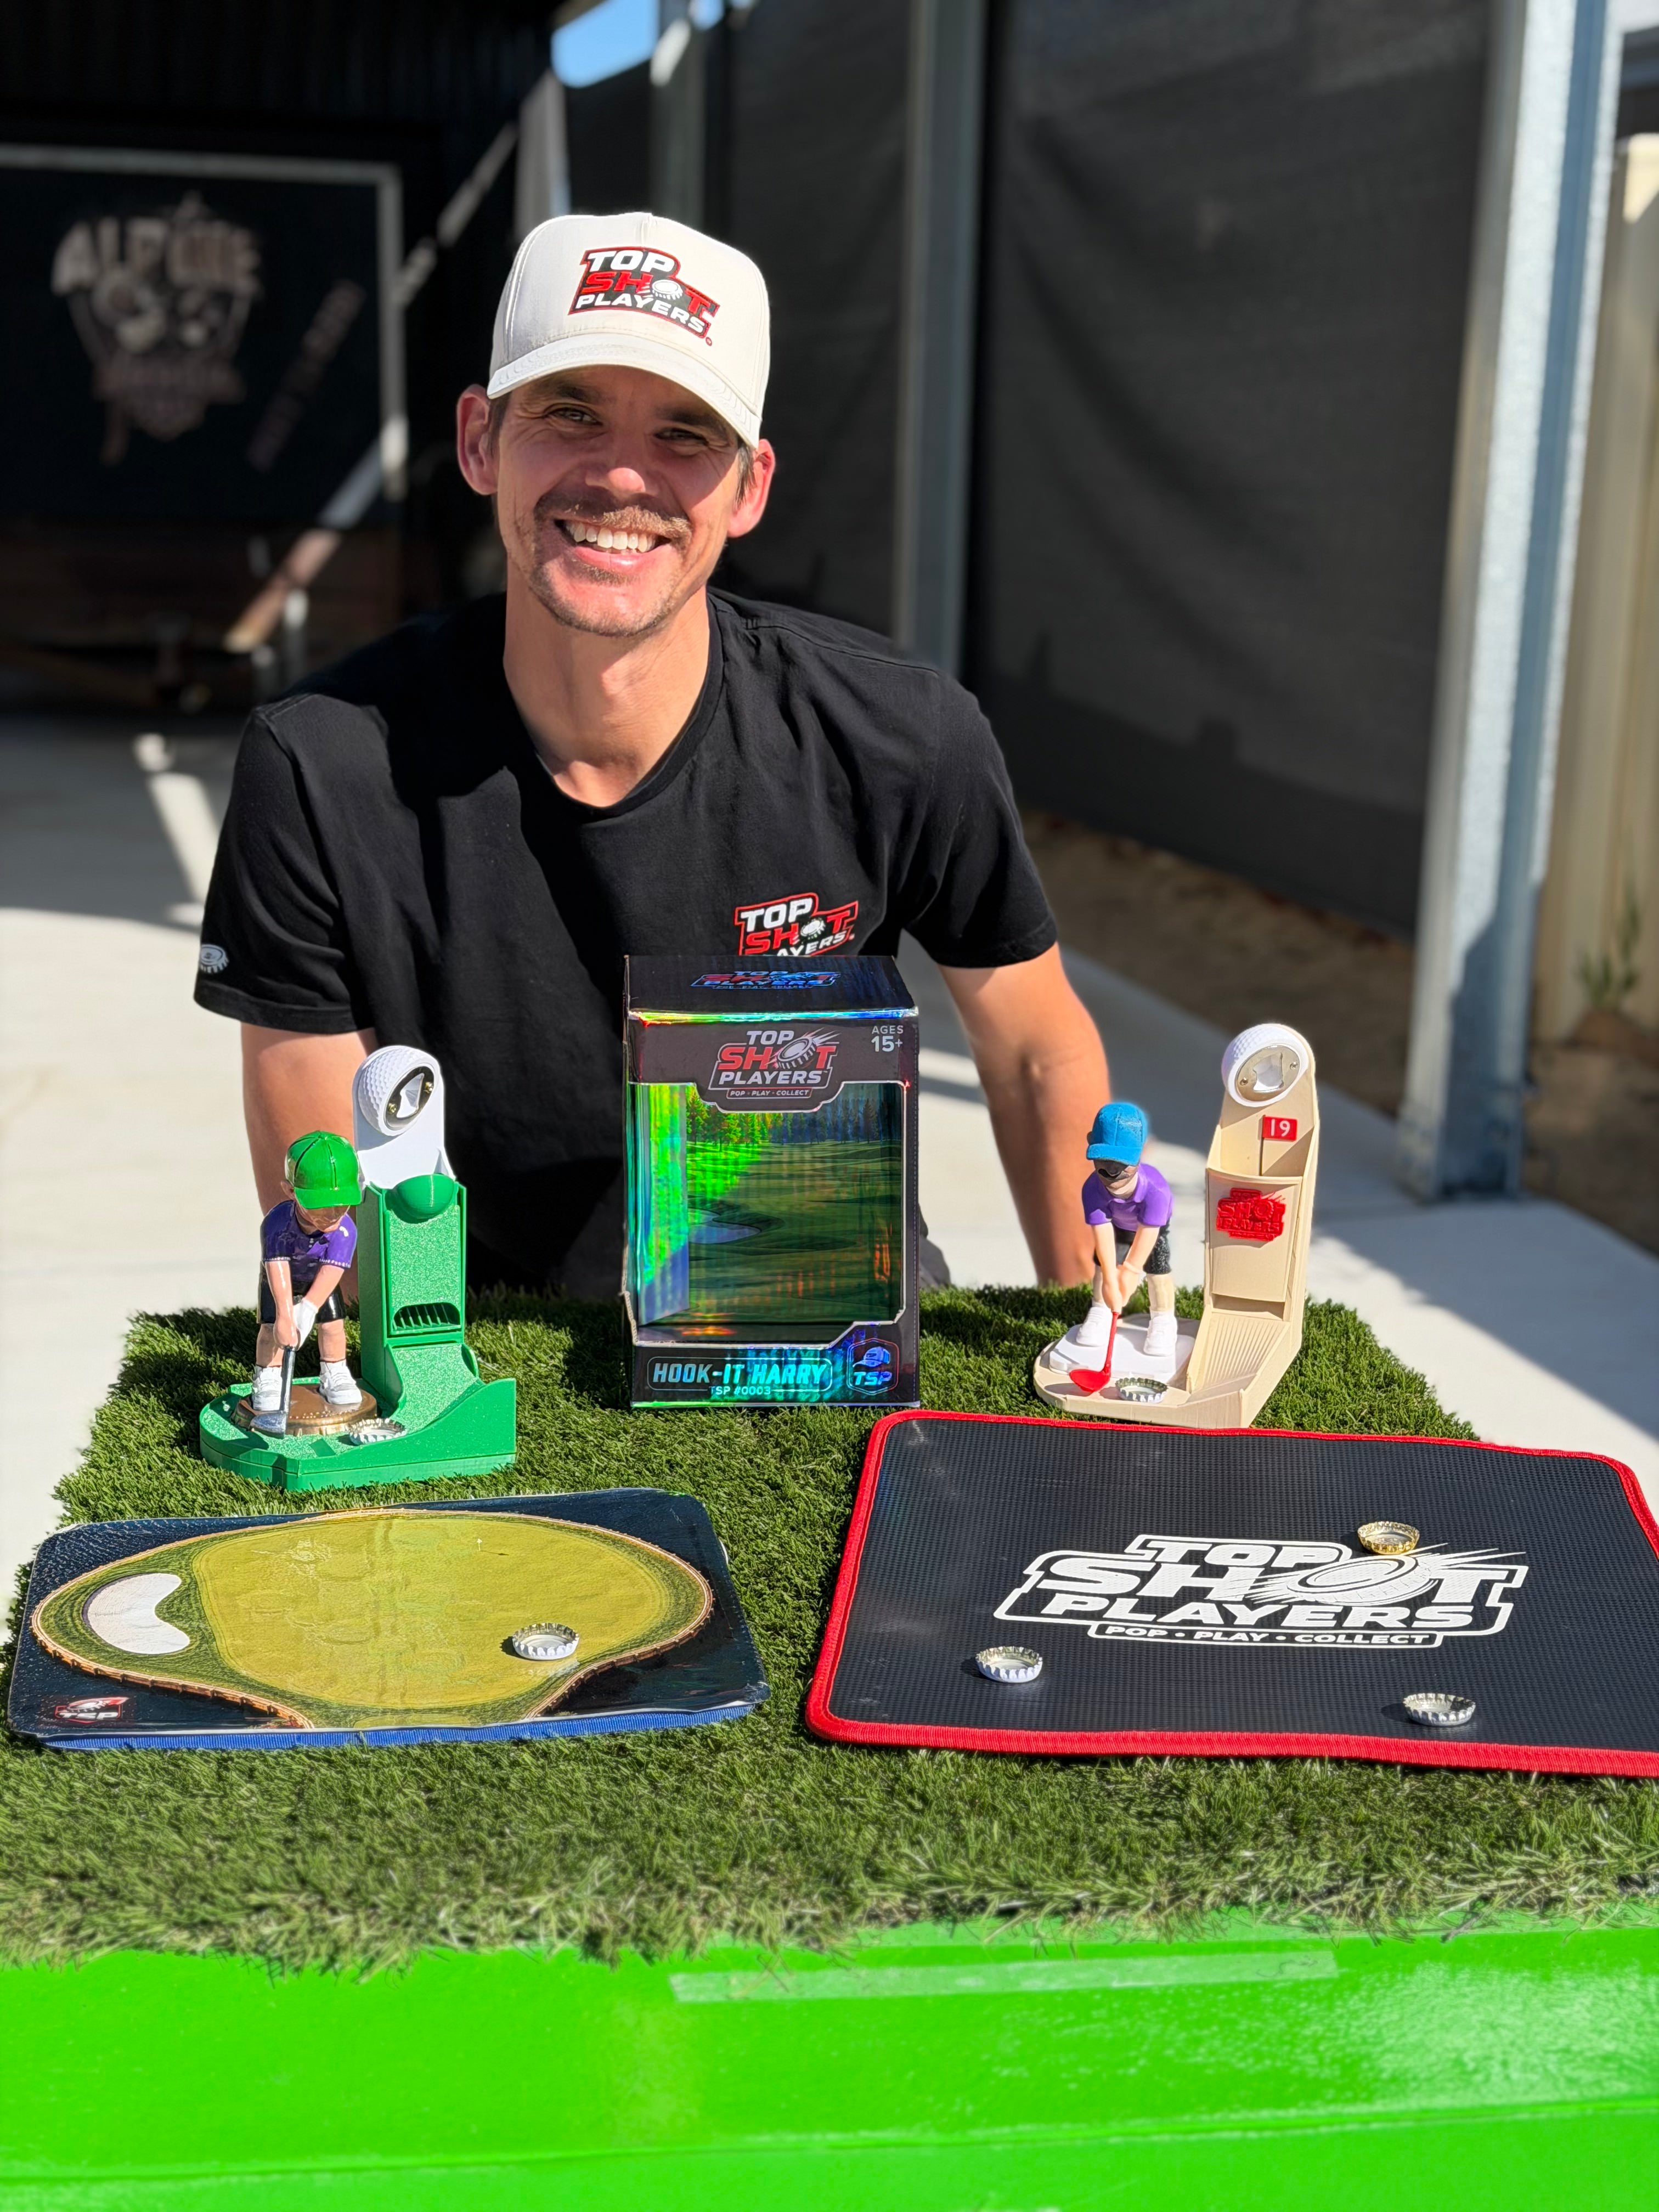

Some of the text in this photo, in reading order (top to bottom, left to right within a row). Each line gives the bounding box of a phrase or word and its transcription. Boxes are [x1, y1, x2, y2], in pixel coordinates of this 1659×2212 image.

[588, 250, 675, 272] TOP
[575, 293, 706, 333] PLAYERS
[741, 898, 813, 932] TOP
[763, 930, 848, 956] AYERS
[746, 1030, 794, 1045] TOP
[871, 1025, 904, 1035] AGES
[871, 1036, 904, 1052] 15+
[718, 1071, 823, 1085] PLAYERS
[1271, 1119, 1290, 1137] 19
[652, 1363, 827, 1384] HOOK-IT HARRY
[854, 1371, 893, 1385] TSP
[709, 1386, 771, 1395] TSP #0003
[1146, 1540, 1341, 1568] TOP
[1040, 1593, 1475, 1628] PLAYERS
[1104, 1626, 1431, 1644] POP PLAY COLLECT
[59, 1712, 119, 1720] TSP
